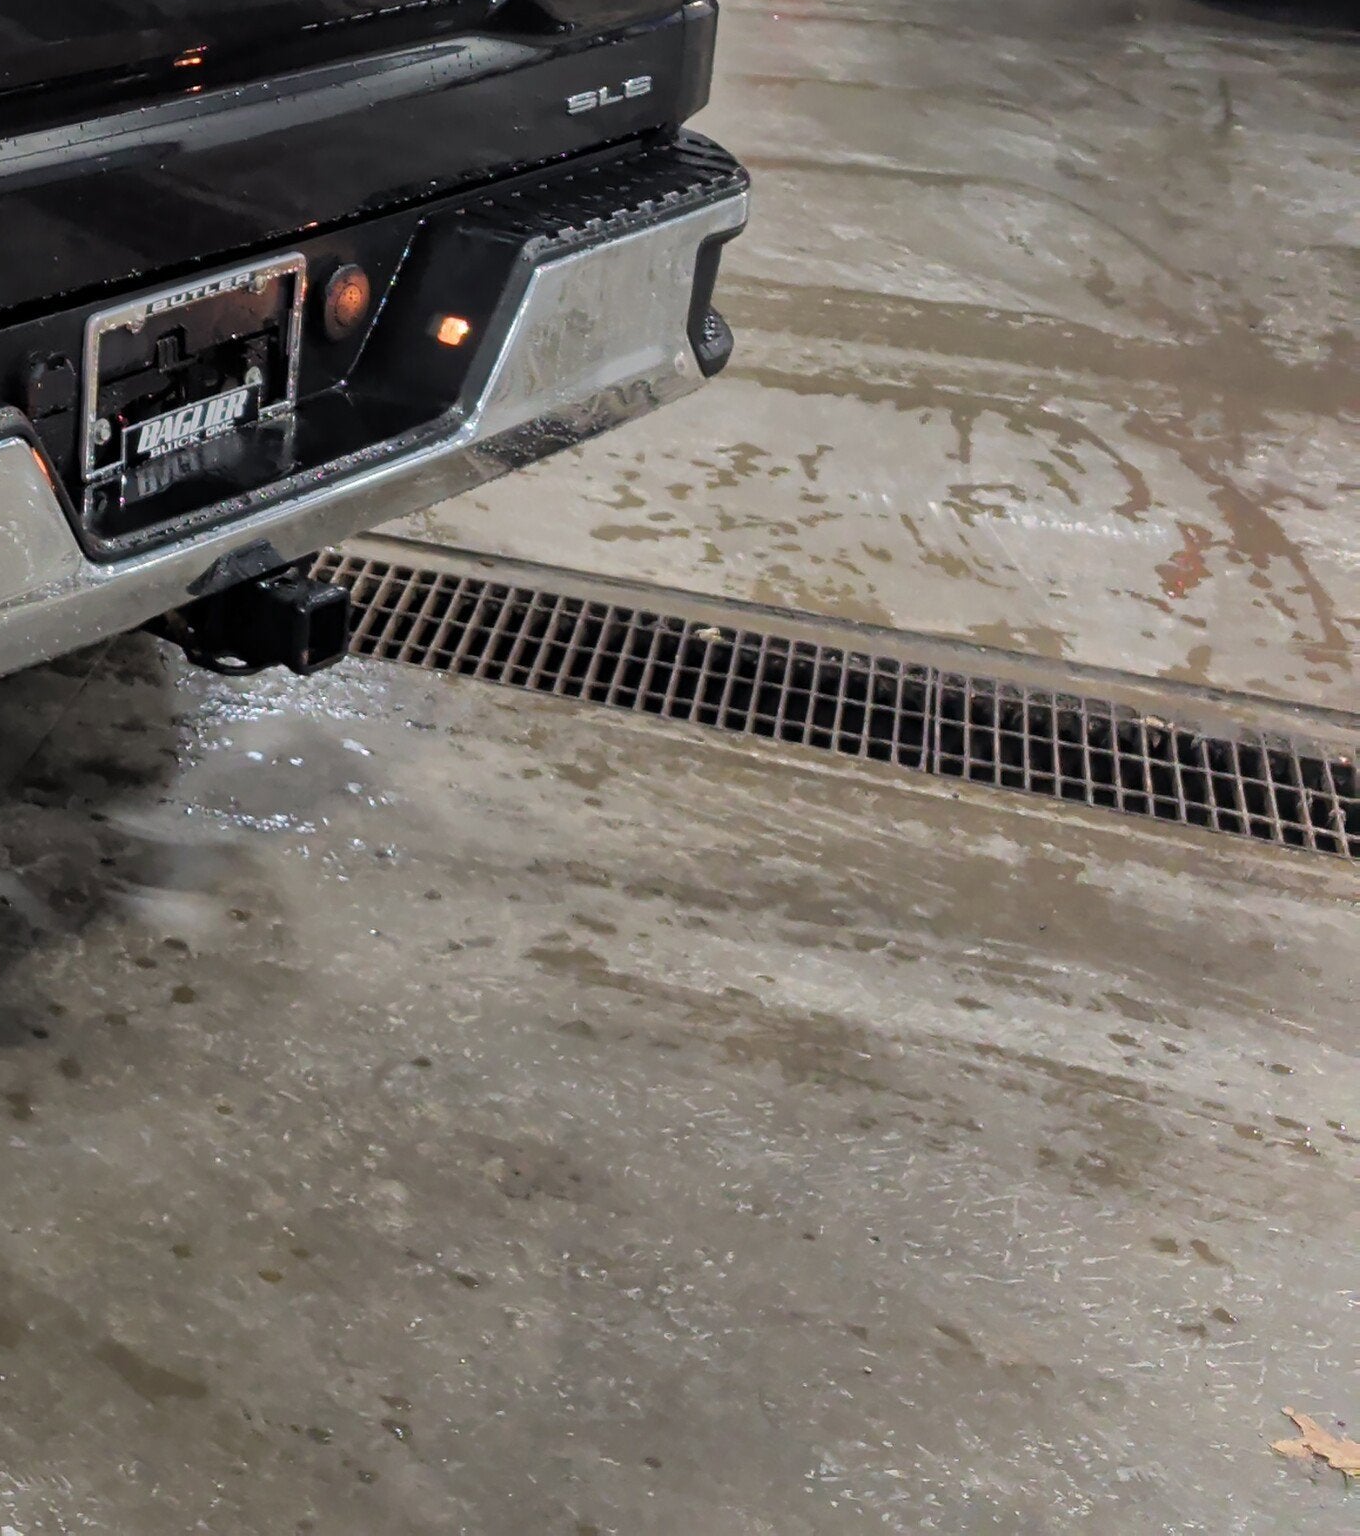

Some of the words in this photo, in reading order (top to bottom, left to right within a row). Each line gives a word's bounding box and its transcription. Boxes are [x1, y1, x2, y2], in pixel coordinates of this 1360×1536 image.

[566, 75, 653, 115] SLE
[151, 272, 252, 313] BUTLER
[137, 389, 249, 454] BAGLIER
[149, 432, 202, 459] BUICK
[205, 419, 234, 438] GMC
